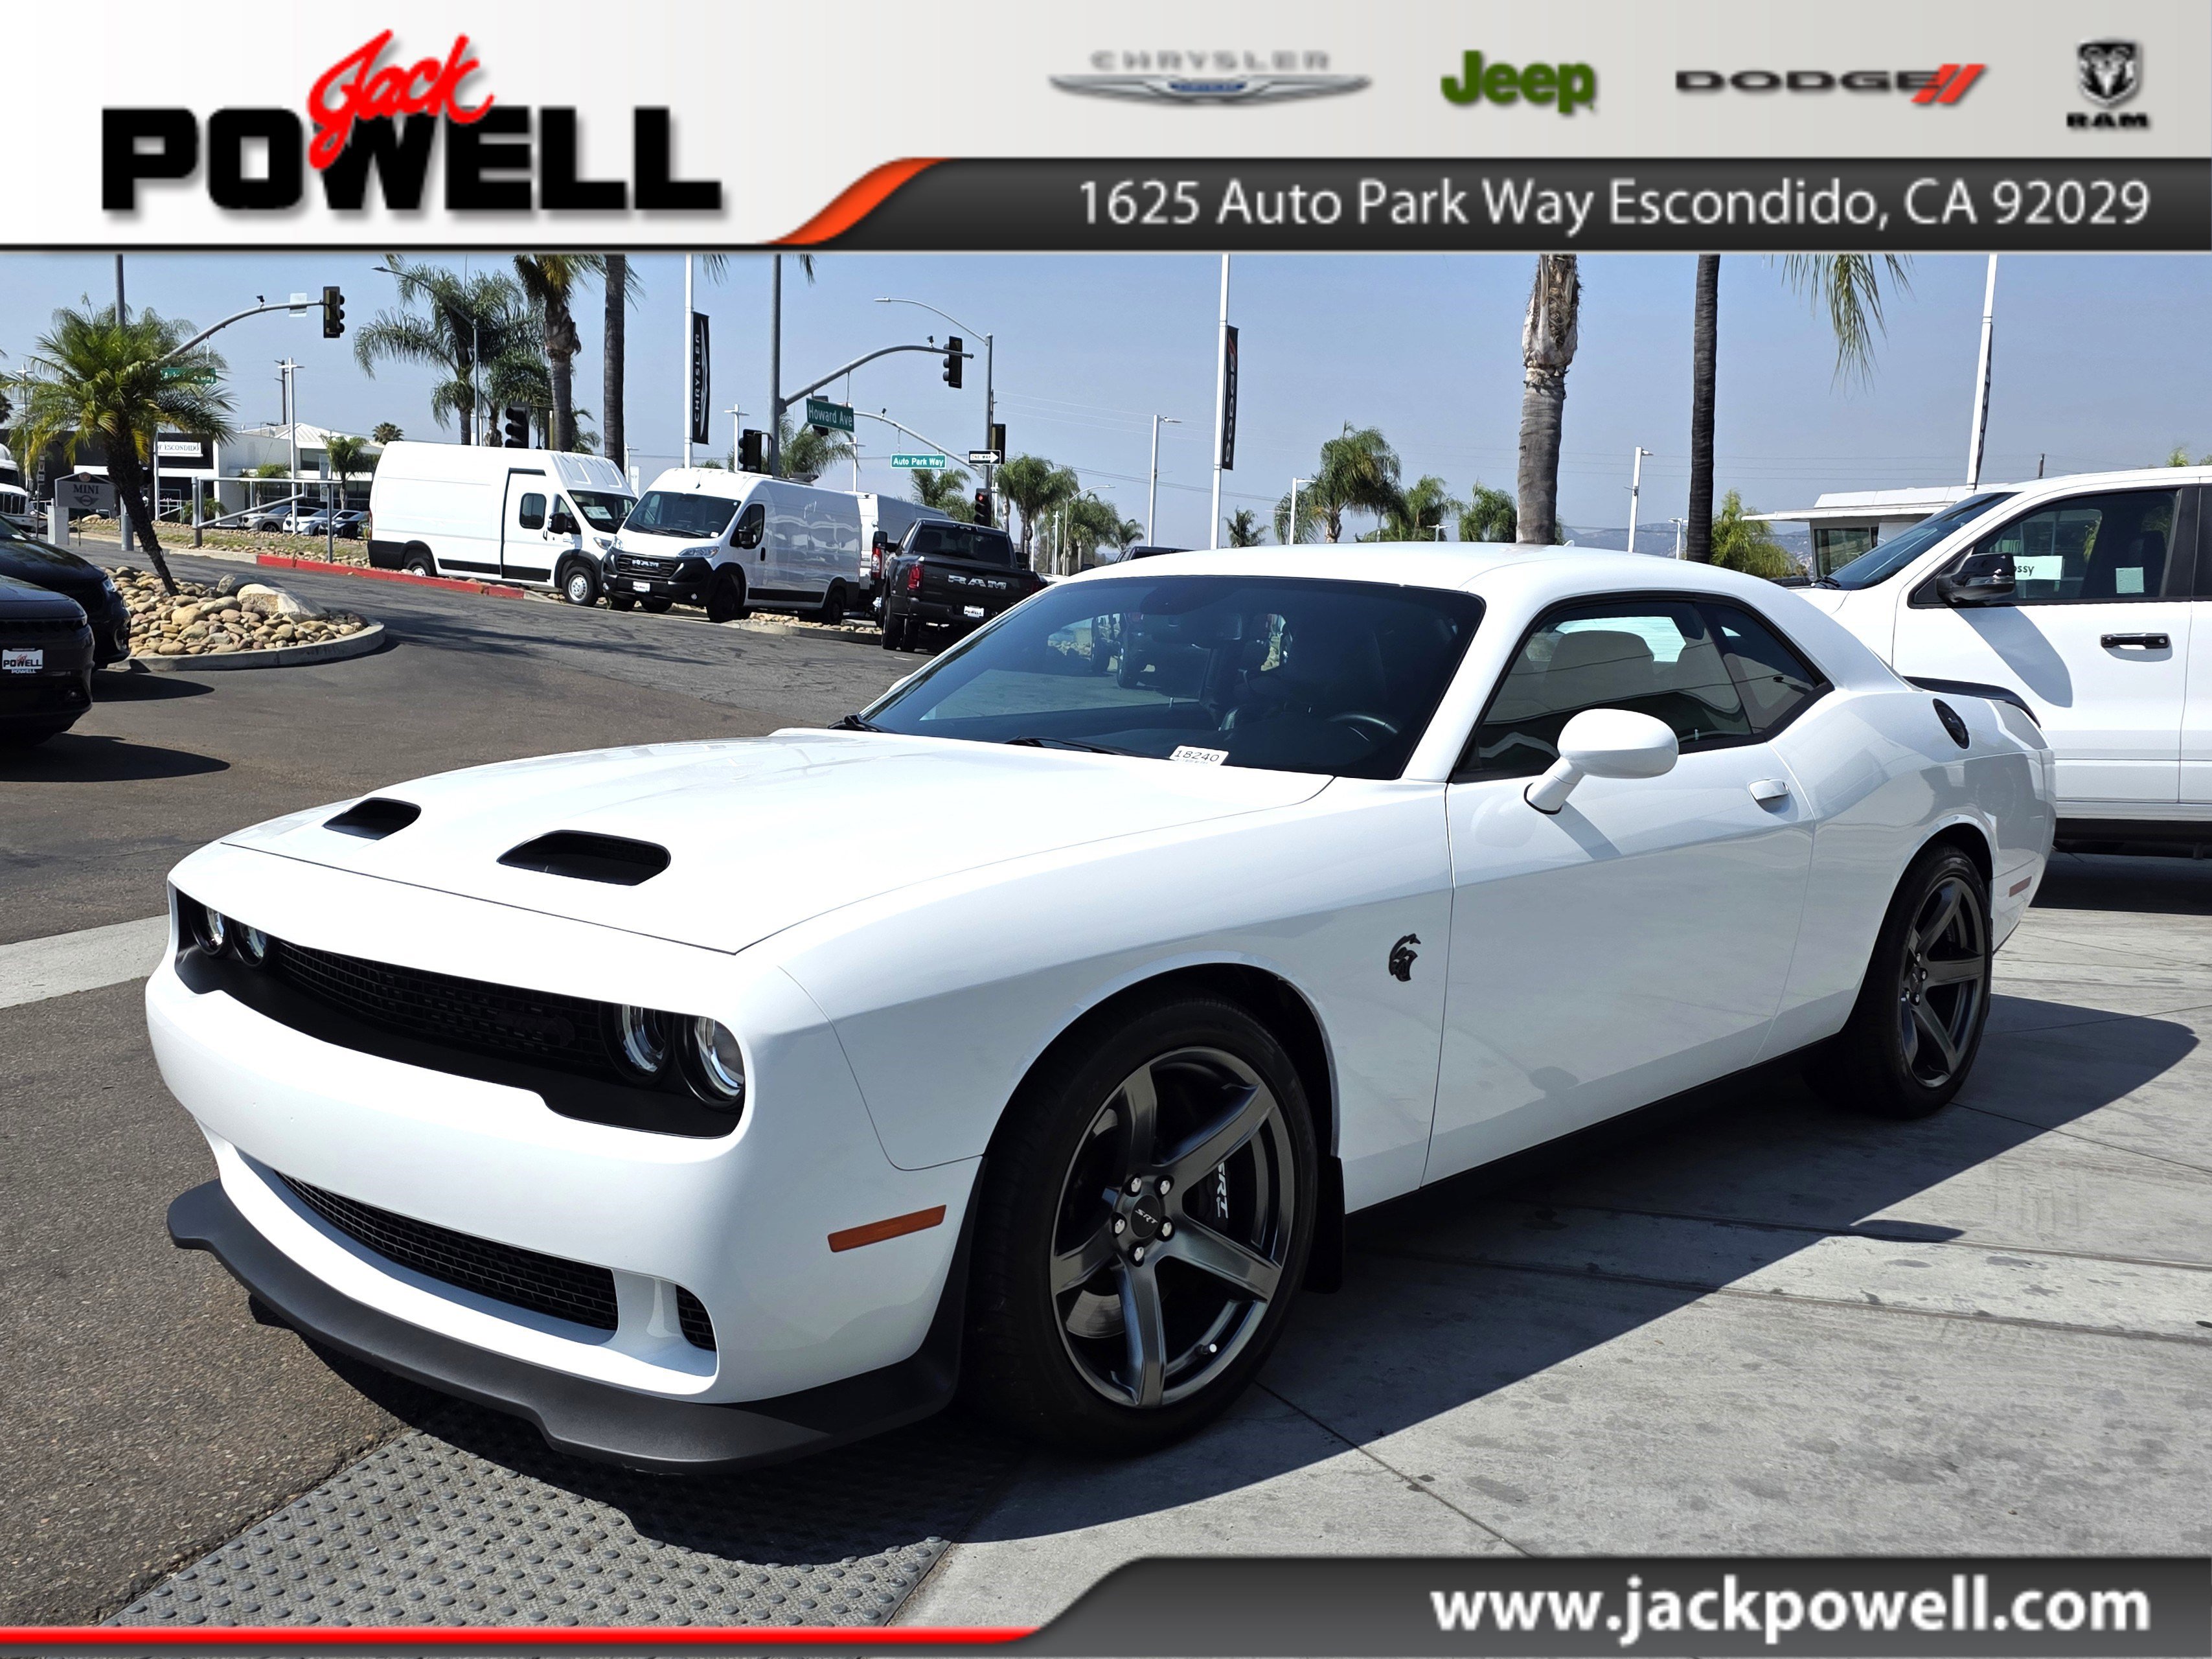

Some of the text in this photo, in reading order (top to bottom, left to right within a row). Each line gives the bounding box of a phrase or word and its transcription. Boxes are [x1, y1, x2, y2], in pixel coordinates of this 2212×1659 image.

[808, 404, 852, 427] Howard Ave
[911, 457, 927, 466] Park
[929, 457, 944, 466] Way
[73, 484, 100, 494] MINI
[948, 574, 1007, 590] RAM
[3, 659, 42, 668] POWELL
[1174, 749, 1220, 762] 18240
[1135, 1208, 1158, 1224] SRT
